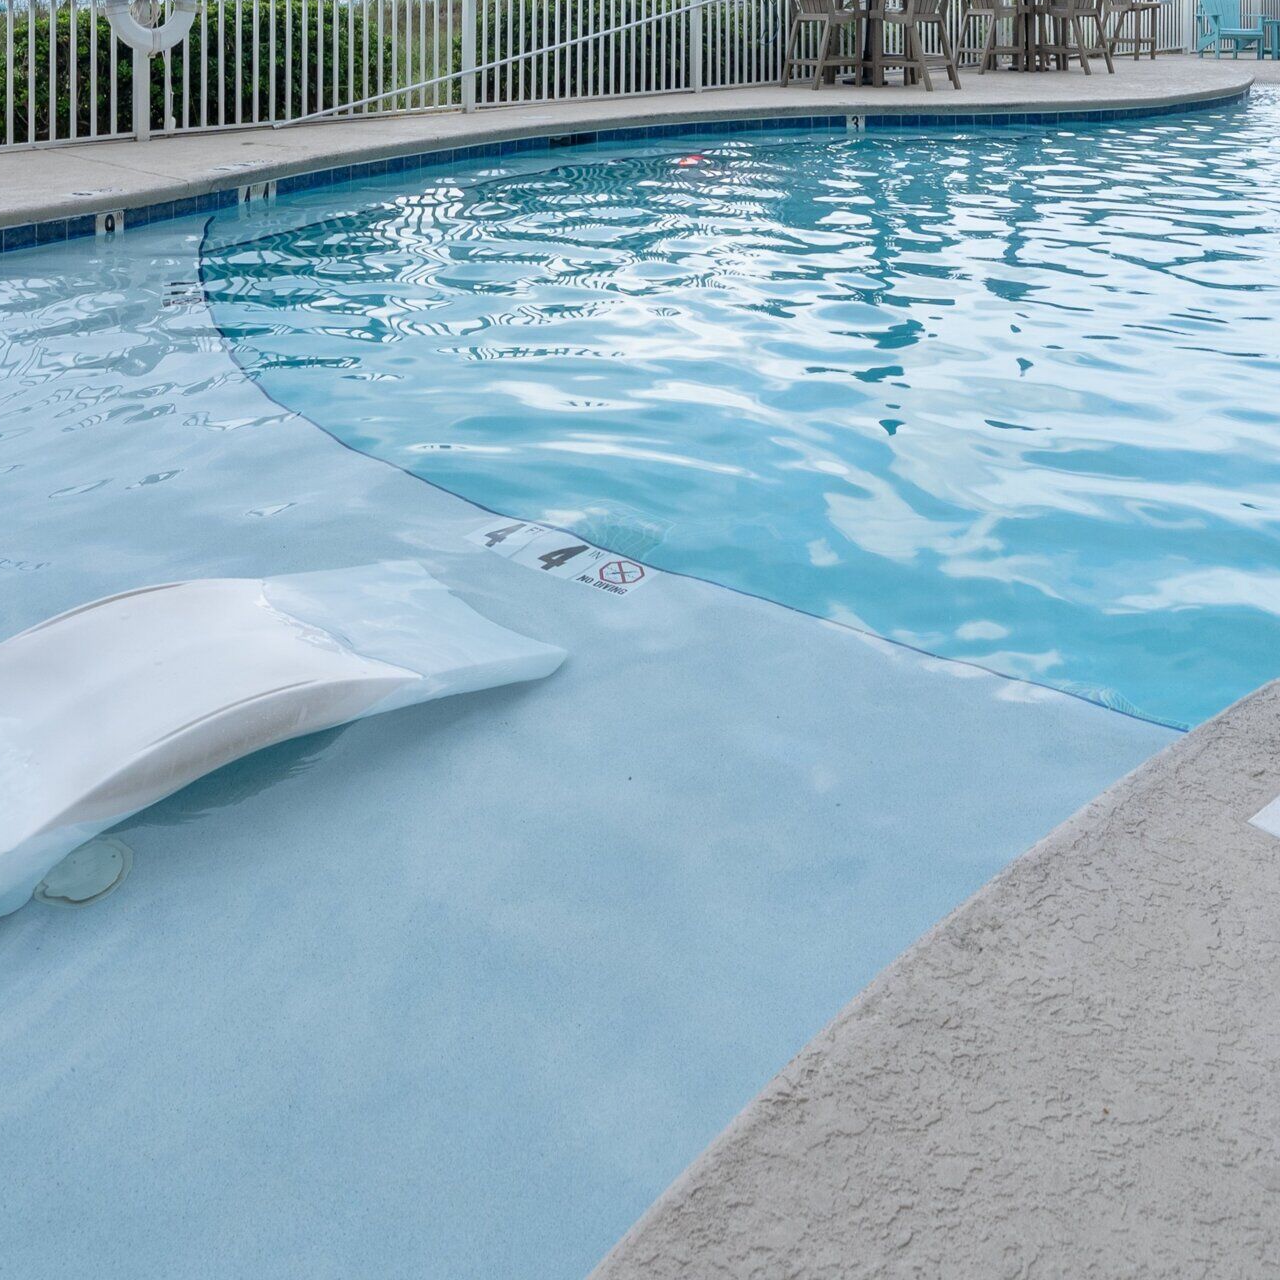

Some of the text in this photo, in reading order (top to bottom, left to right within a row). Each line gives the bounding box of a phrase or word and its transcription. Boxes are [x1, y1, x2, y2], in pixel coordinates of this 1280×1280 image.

[484, 523, 605, 571] 4 FT 4 IN
[576, 574, 629, 595] NO DIVING
